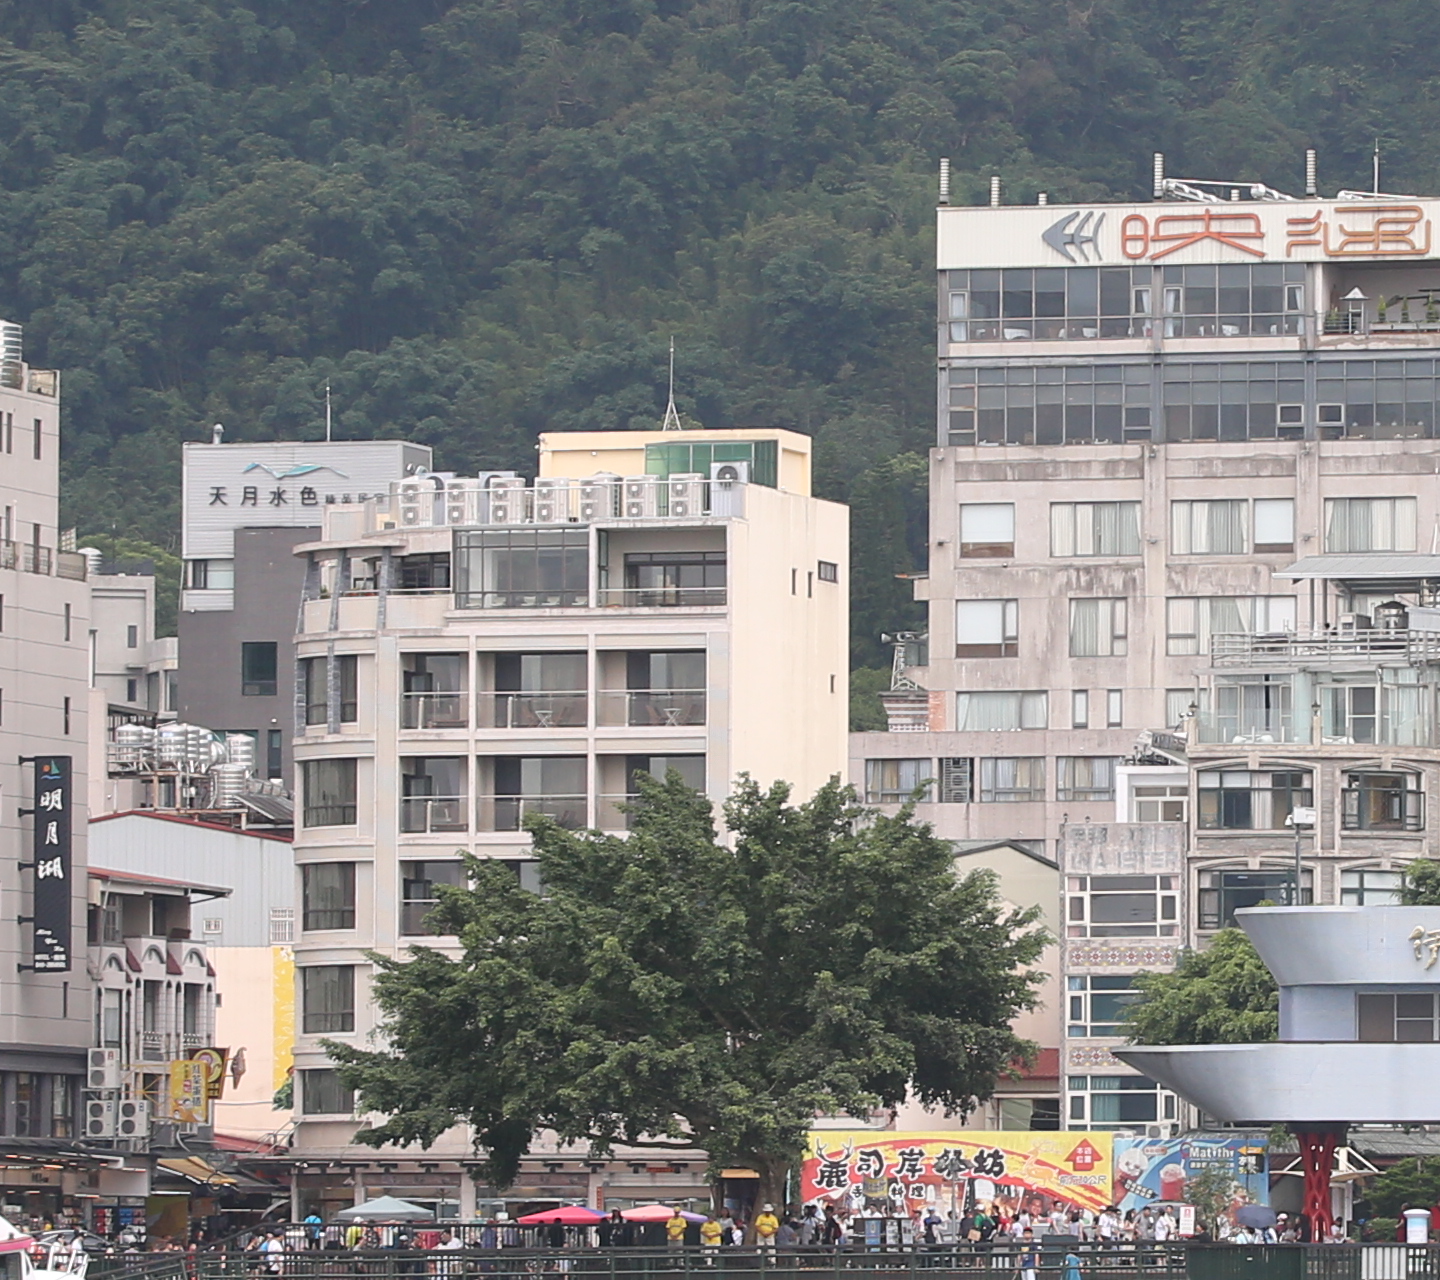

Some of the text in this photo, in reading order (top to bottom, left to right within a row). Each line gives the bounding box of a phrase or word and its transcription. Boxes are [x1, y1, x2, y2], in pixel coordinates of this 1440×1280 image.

[209, 485, 319, 507] 天月水色
[37, 787, 65, 880] 明月湖
